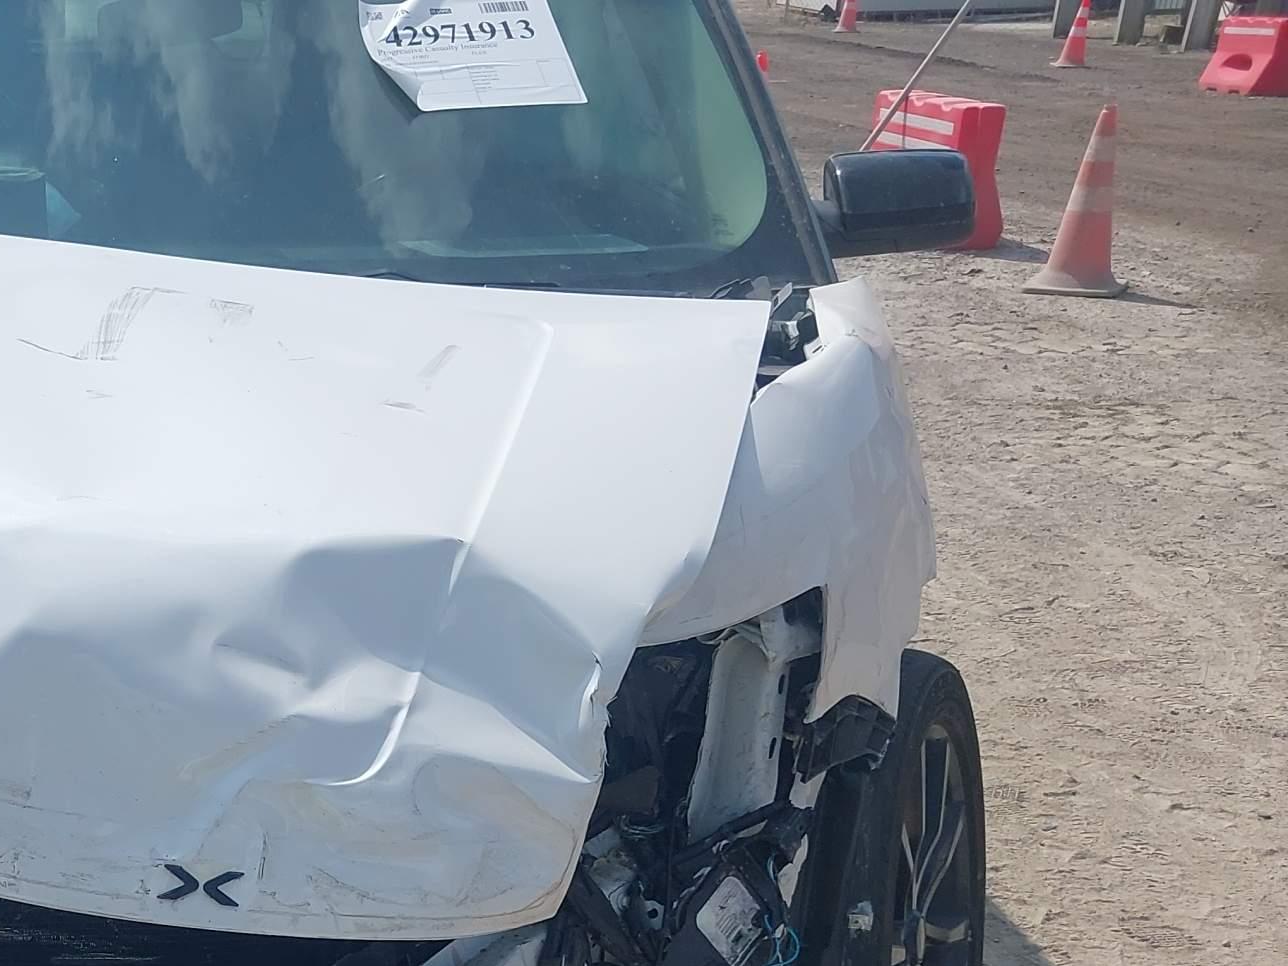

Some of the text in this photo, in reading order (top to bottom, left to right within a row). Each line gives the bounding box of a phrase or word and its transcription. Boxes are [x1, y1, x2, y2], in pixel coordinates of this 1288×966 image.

[385, 20, 535, 47] 42971913
[377, 47, 423, 57] Progressive
[425, 44, 458, 53] Casualty
[461, 42, 498, 50] Insurance
